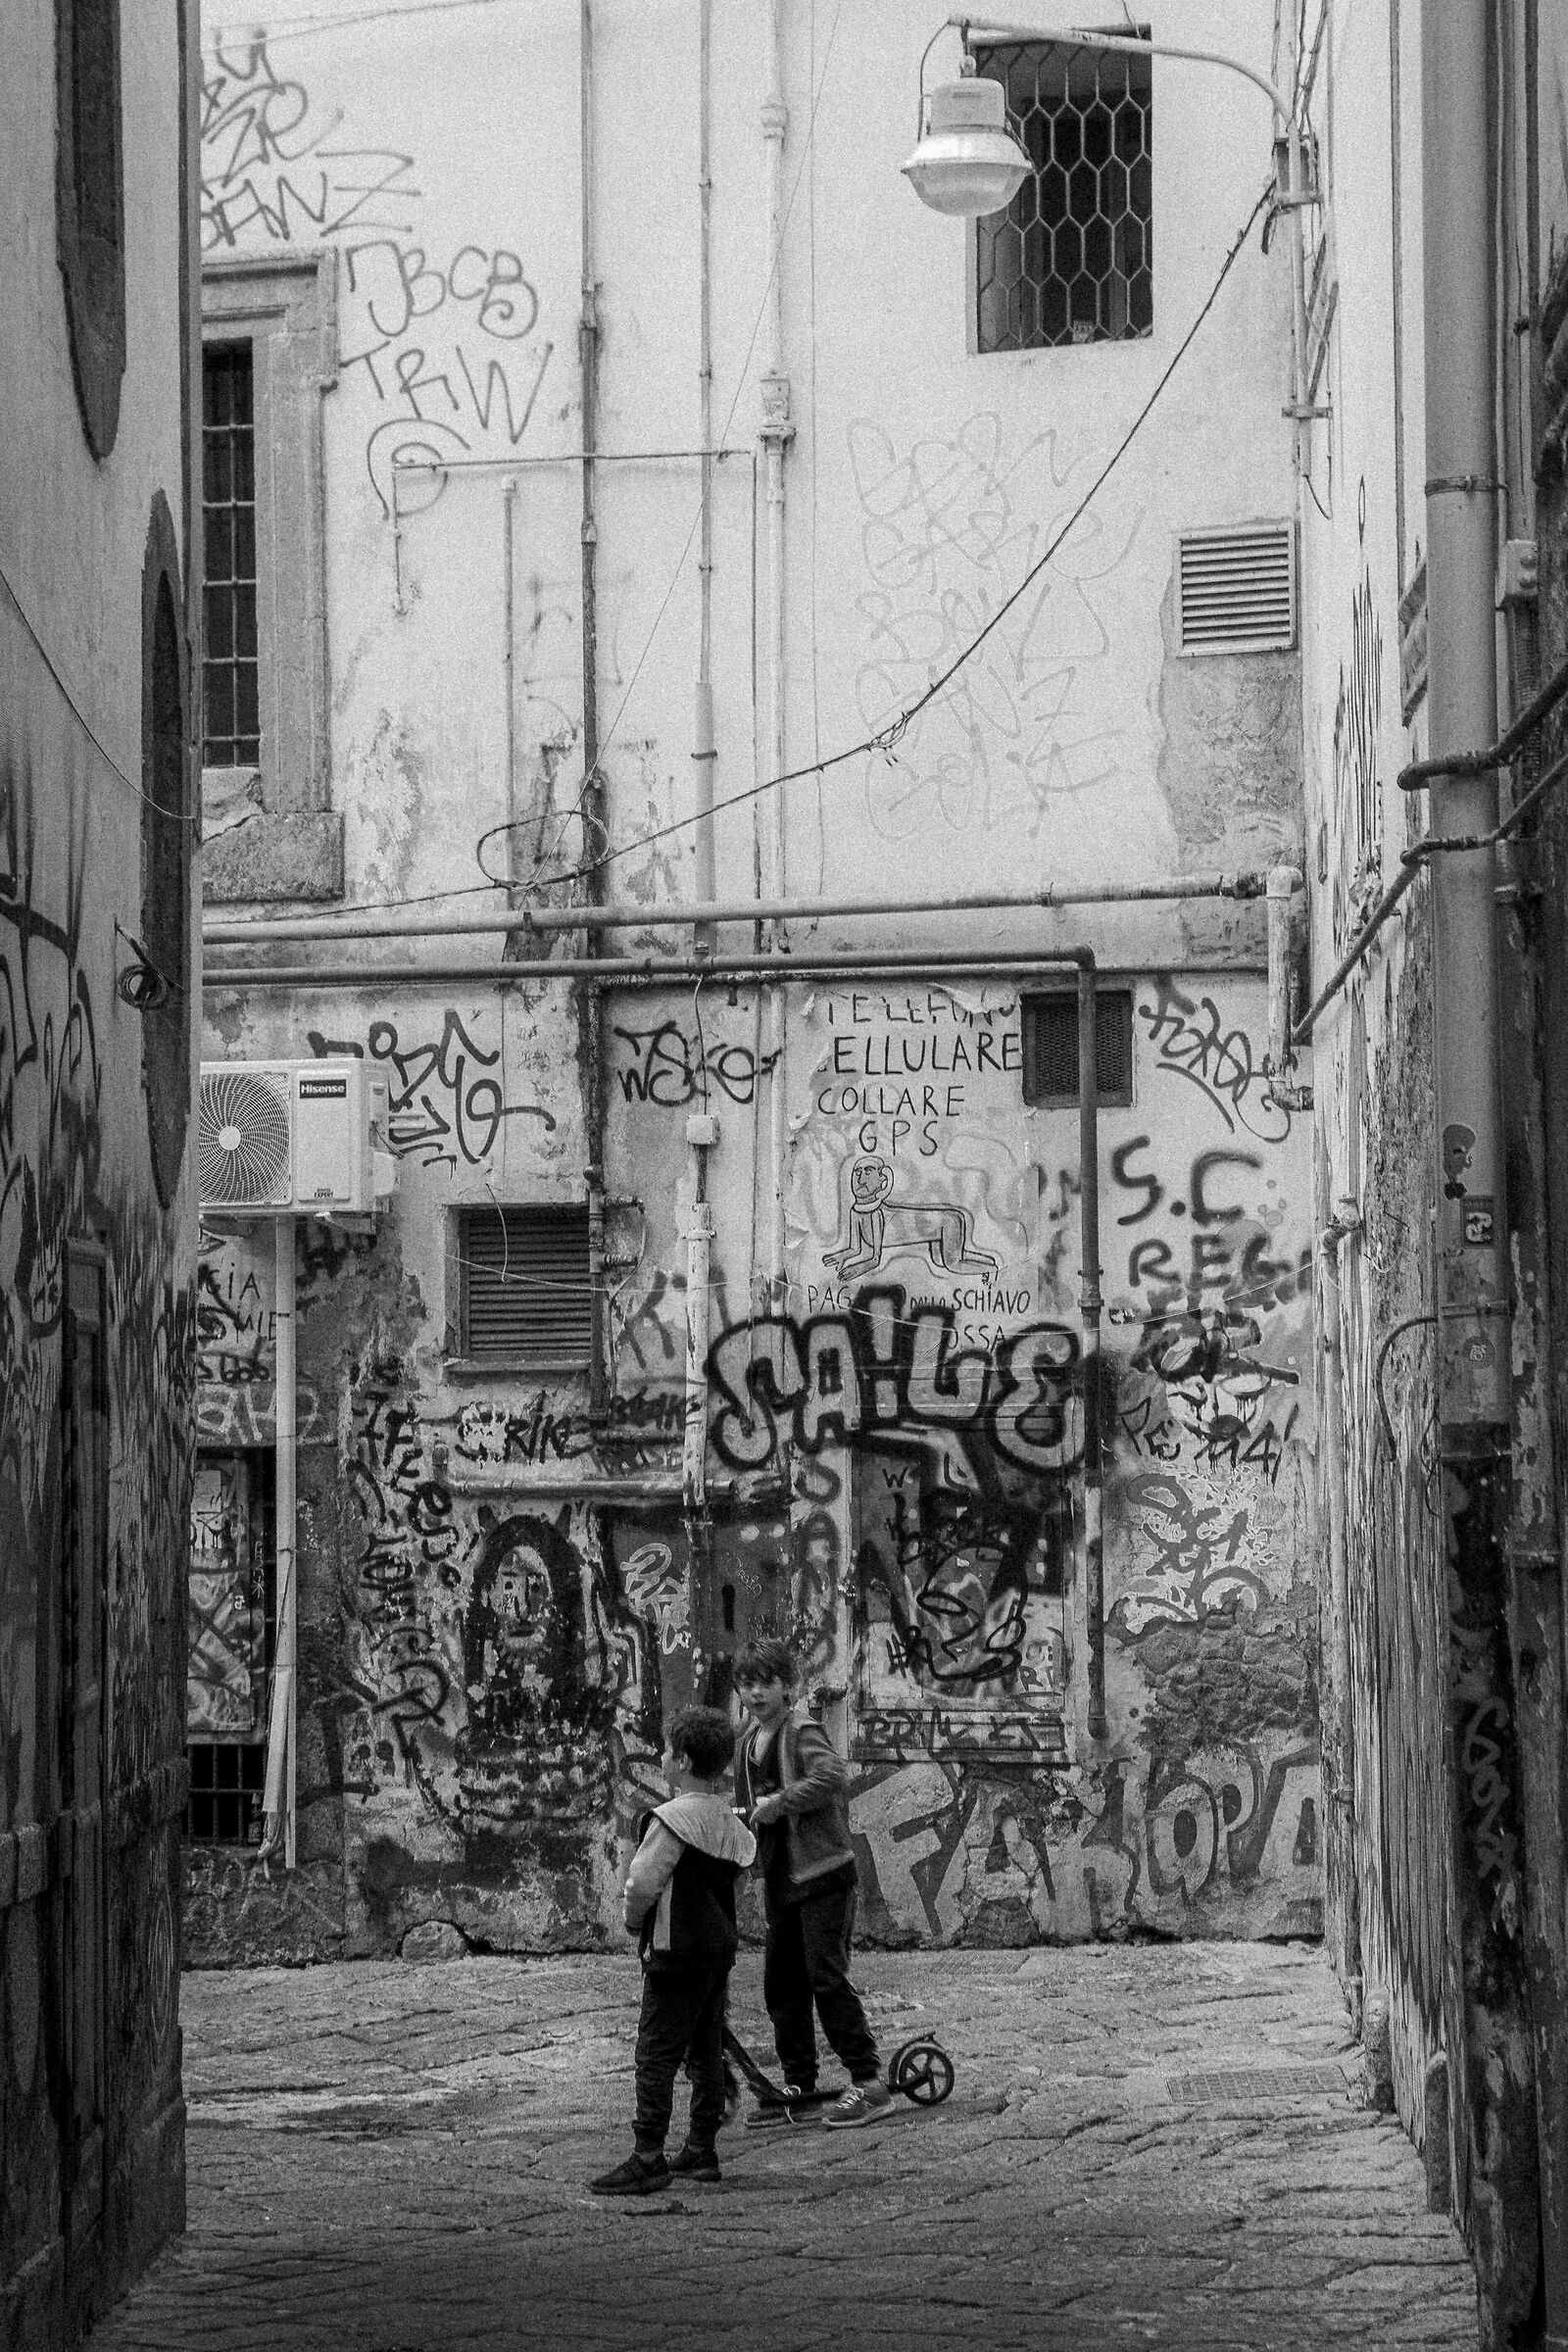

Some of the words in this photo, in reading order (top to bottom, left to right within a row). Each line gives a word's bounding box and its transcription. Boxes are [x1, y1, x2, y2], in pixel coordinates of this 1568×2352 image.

[816, 1032, 1023, 1075] ELLULARE
[300, 1084, 346, 1094] Hisense
[817, 1085, 965, 1117] COLLARE
[951, 1286, 1031, 1314] SCHIAVO
